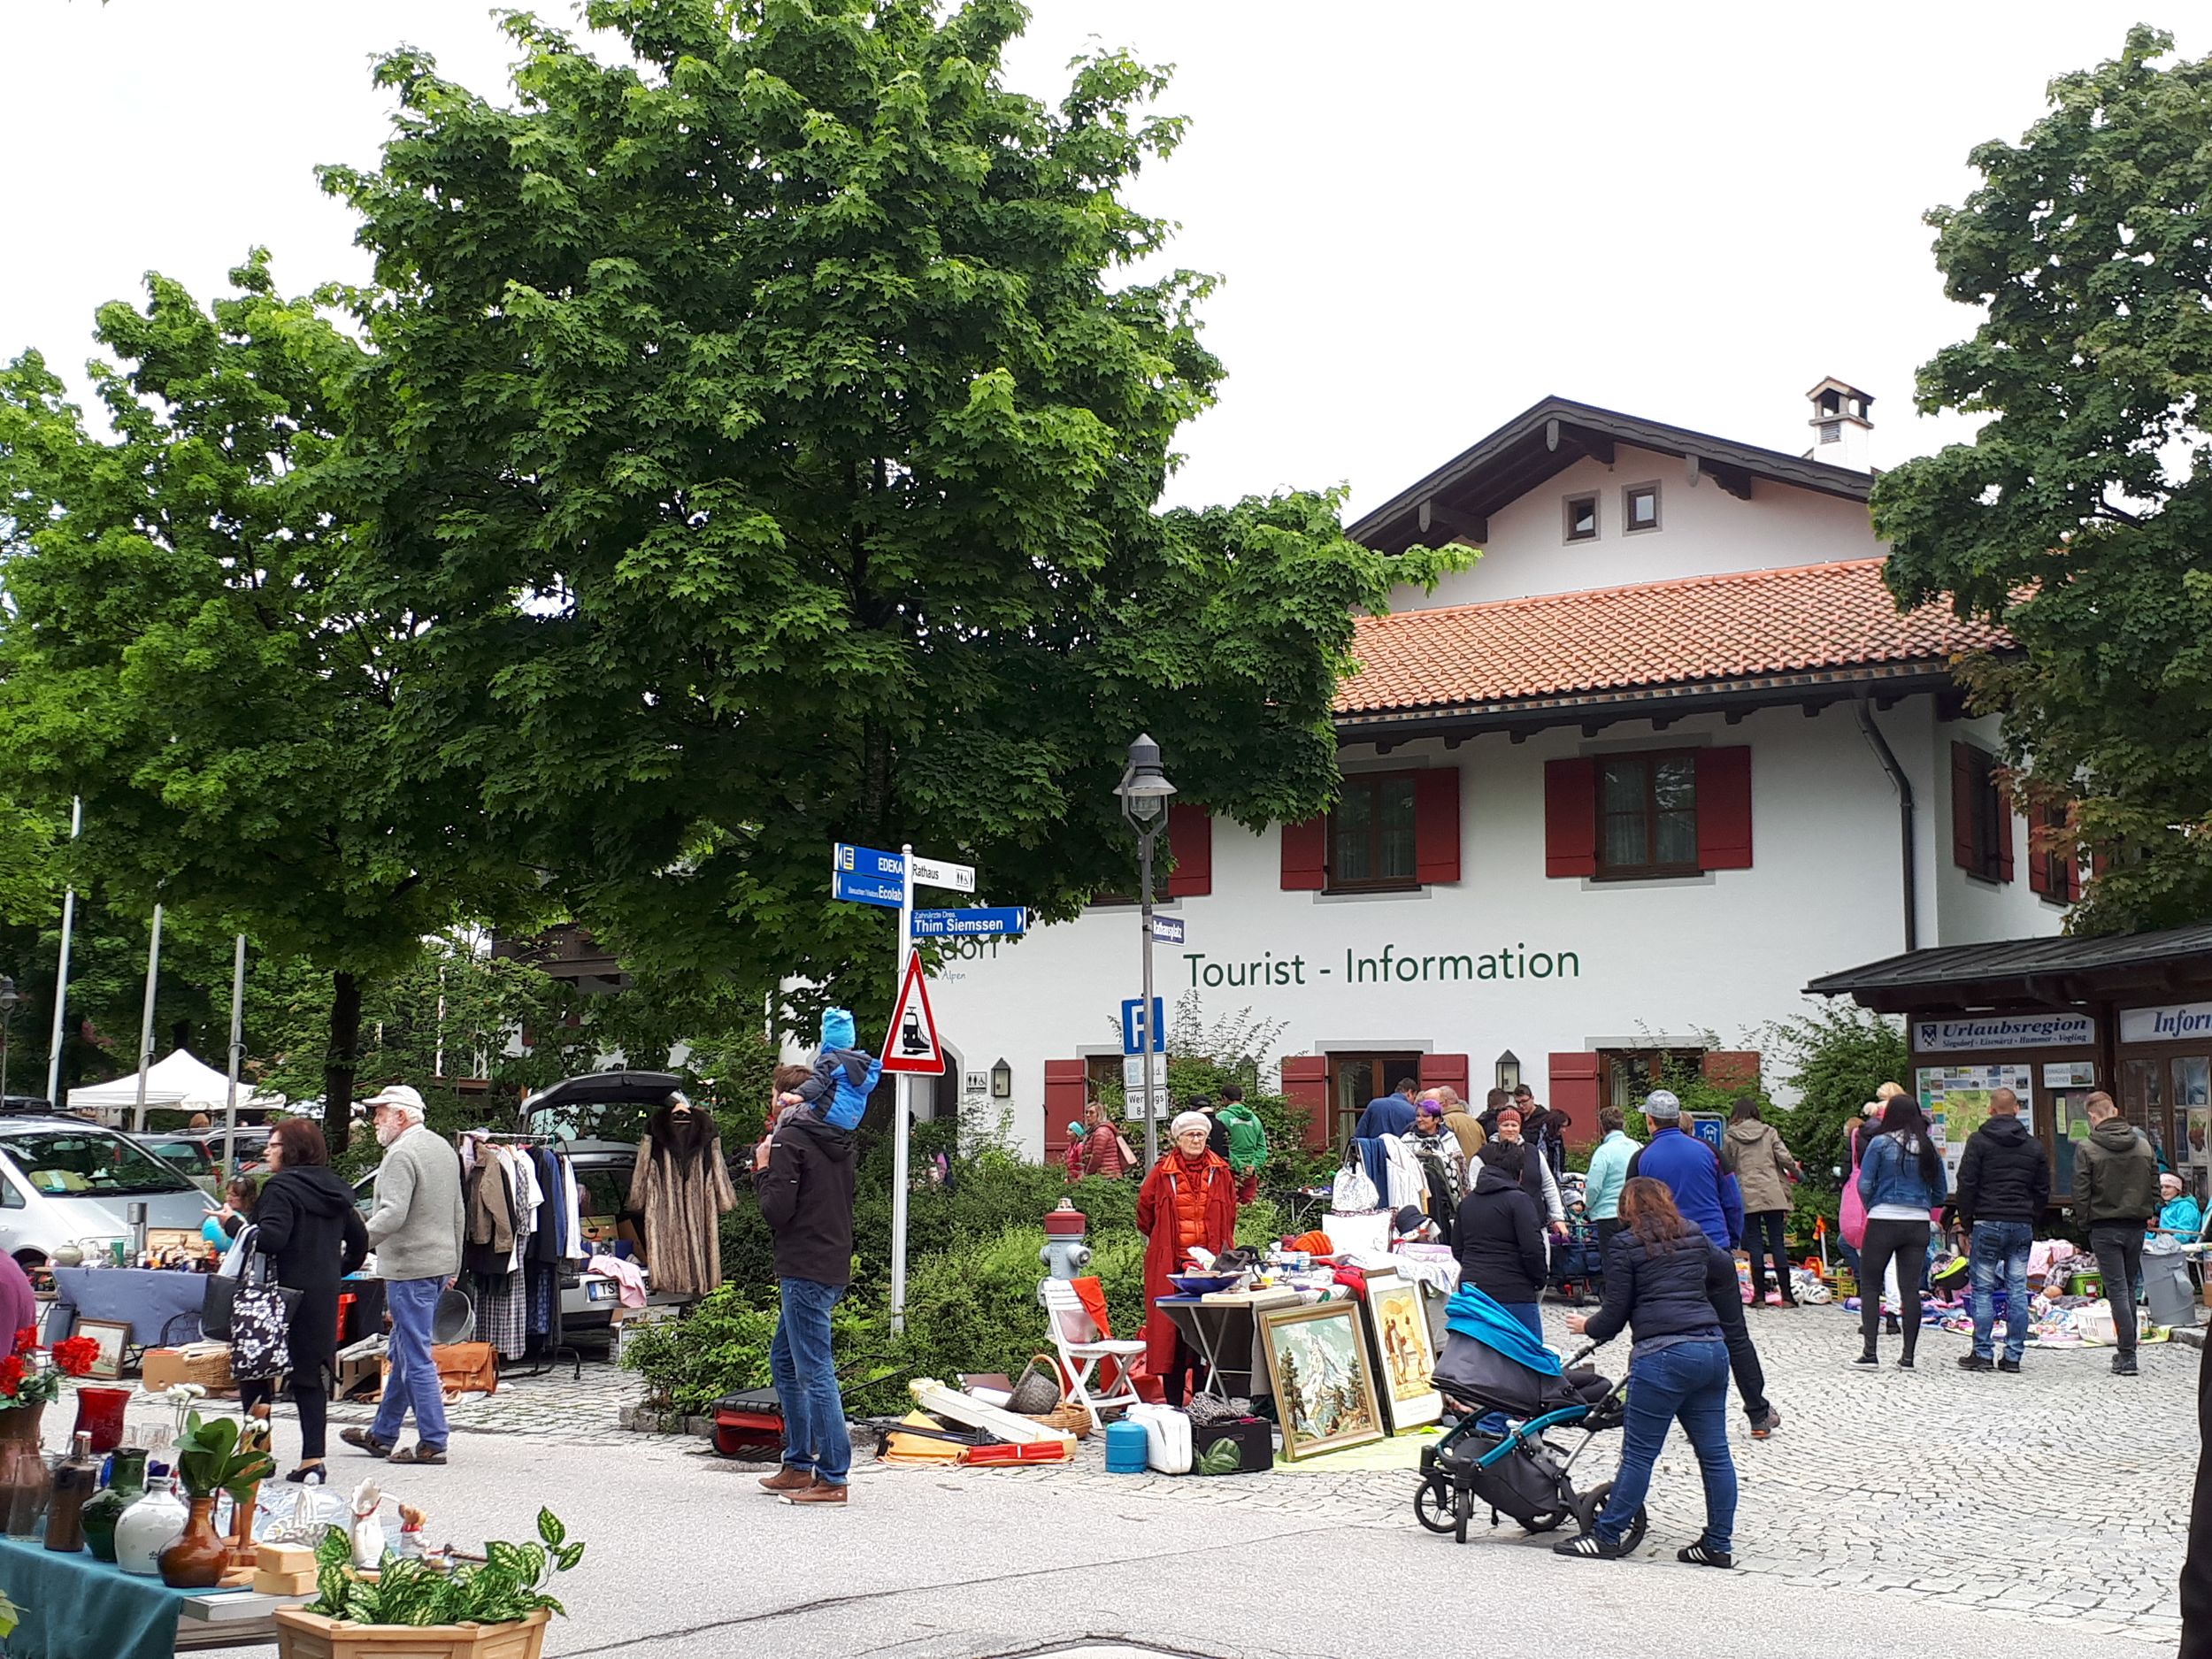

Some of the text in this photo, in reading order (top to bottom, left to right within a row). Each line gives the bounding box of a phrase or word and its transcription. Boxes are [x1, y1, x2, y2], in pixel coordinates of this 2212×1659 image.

[878, 856, 903, 875] EDEKA
[913, 864, 939, 879] Rathaus
[879, 885, 902, 902] Ecolab
[915, 918, 1003, 933] Thim Siemssen
[1183, 951, 1305, 987] Tourist
[1347, 942, 1579, 983] Information
[941, 970, 966, 984] Alpen
[1942, 1018, 2086, 1037] Urlaubsregion
[1128, 1094, 1164, 1105] Wergs
